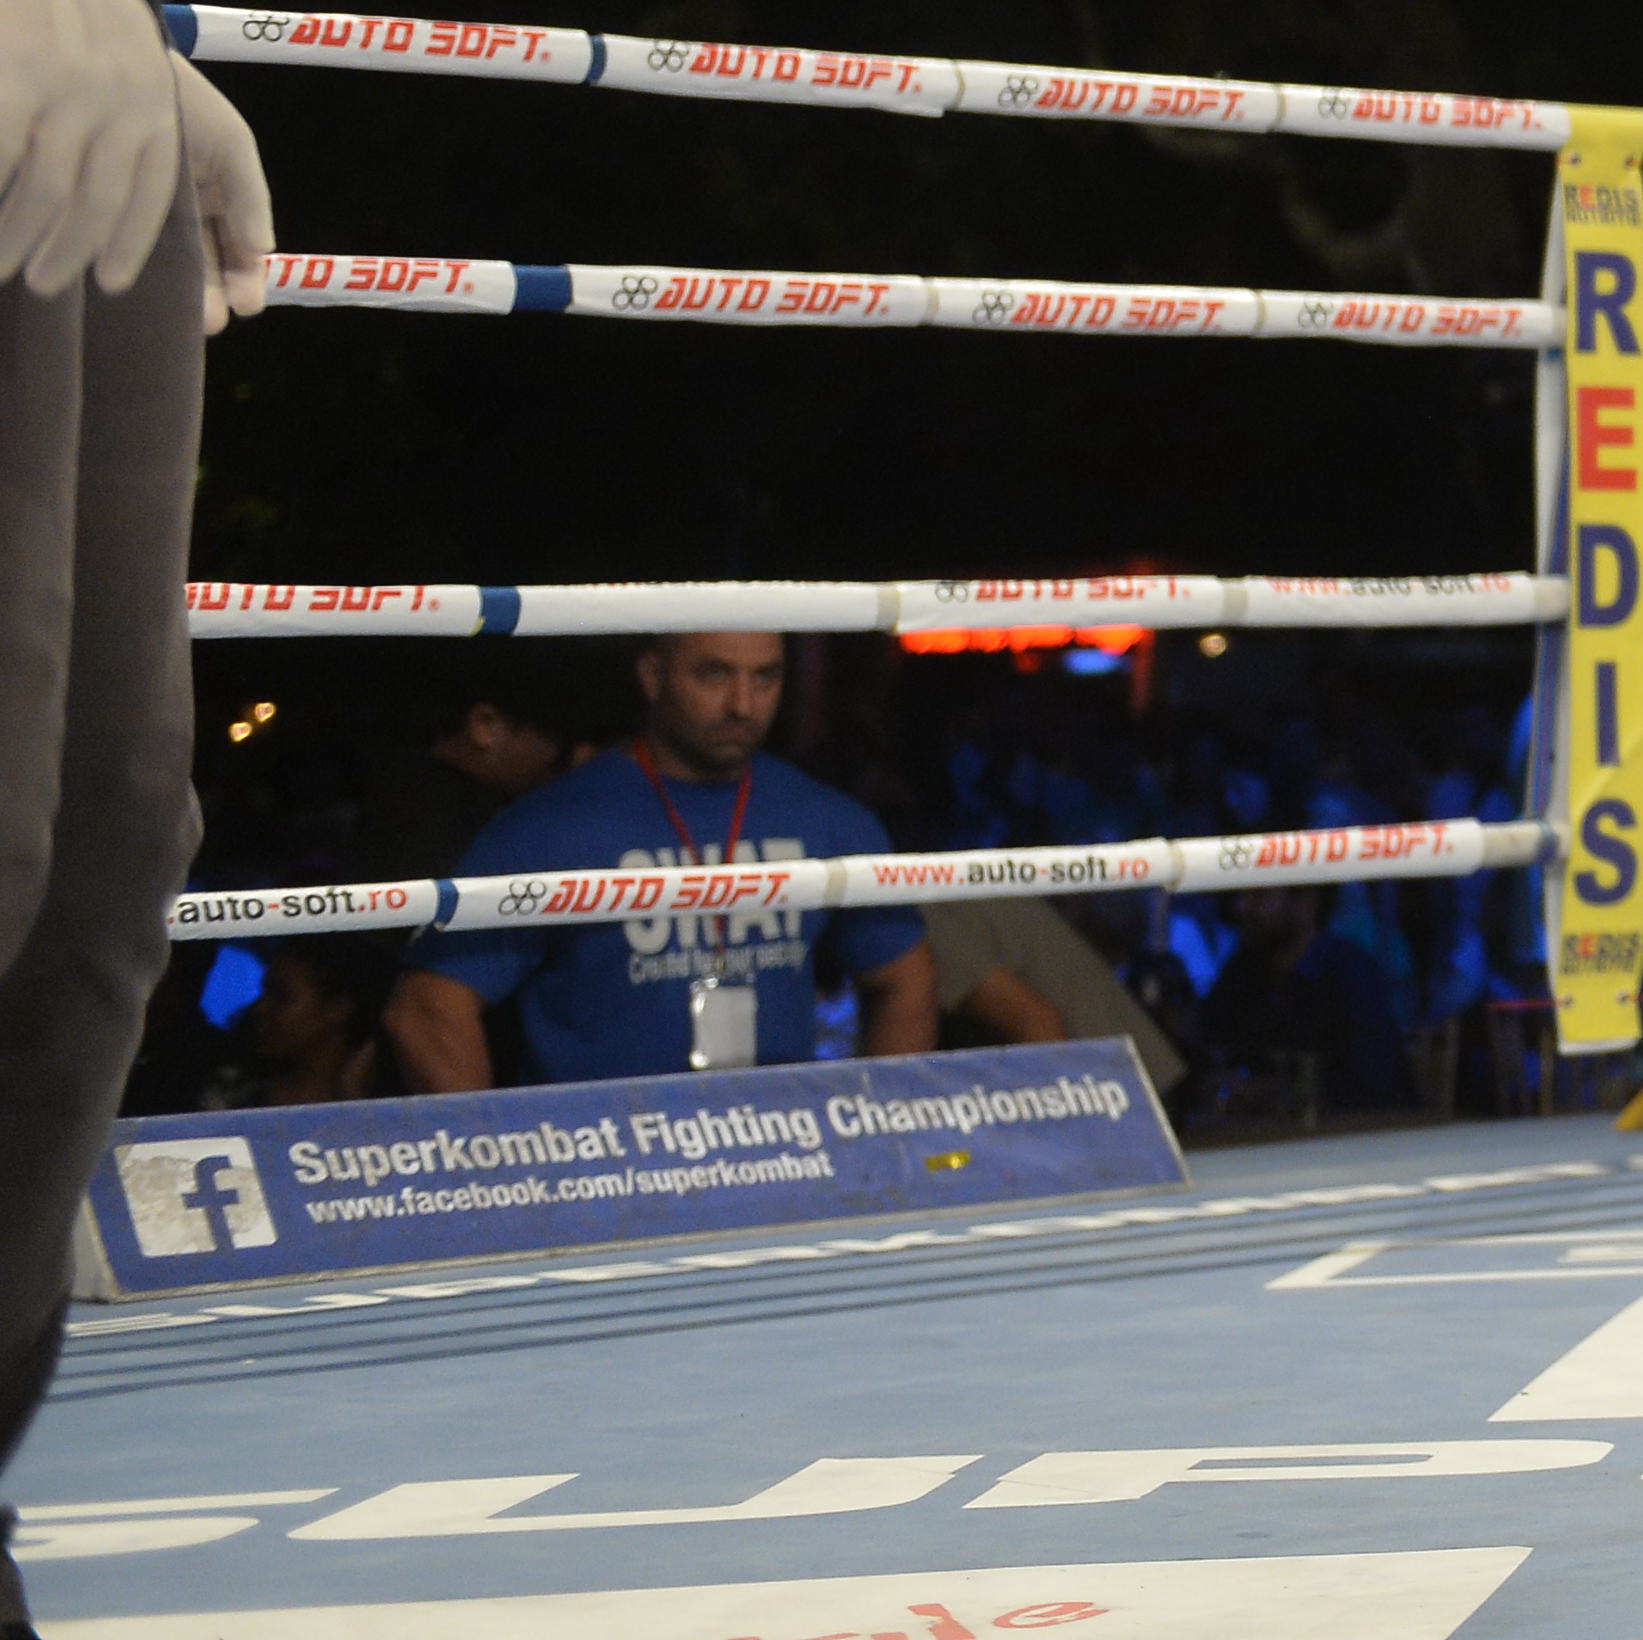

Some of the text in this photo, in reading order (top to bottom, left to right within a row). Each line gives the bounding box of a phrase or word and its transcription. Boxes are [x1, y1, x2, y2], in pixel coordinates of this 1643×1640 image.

[288, 15, 417, 54] AUTO
[688, 42, 804, 83] AUTO
[1034, 77, 1141, 115] AUTO
[264, 253, 335, 291] TO
[654, 275, 773, 312] AUTO
[1011, 292, 1118, 328] AUTO
[1332, 299, 1429, 333] AUTO
[1573, 249, 1642, 907] REDIS
[1254, 828, 1350, 869] AUTO
[873, 852, 1150, 888] www.auto-soft.ro
[166, 885, 409, 926] .auto-soft.ro
[543, 875, 667, 914] AUTO
[290, 1073, 1131, 1193] Superkombat Fighting Championship
[305, 1149, 836, 1226] www.facebook.com/superkombat
